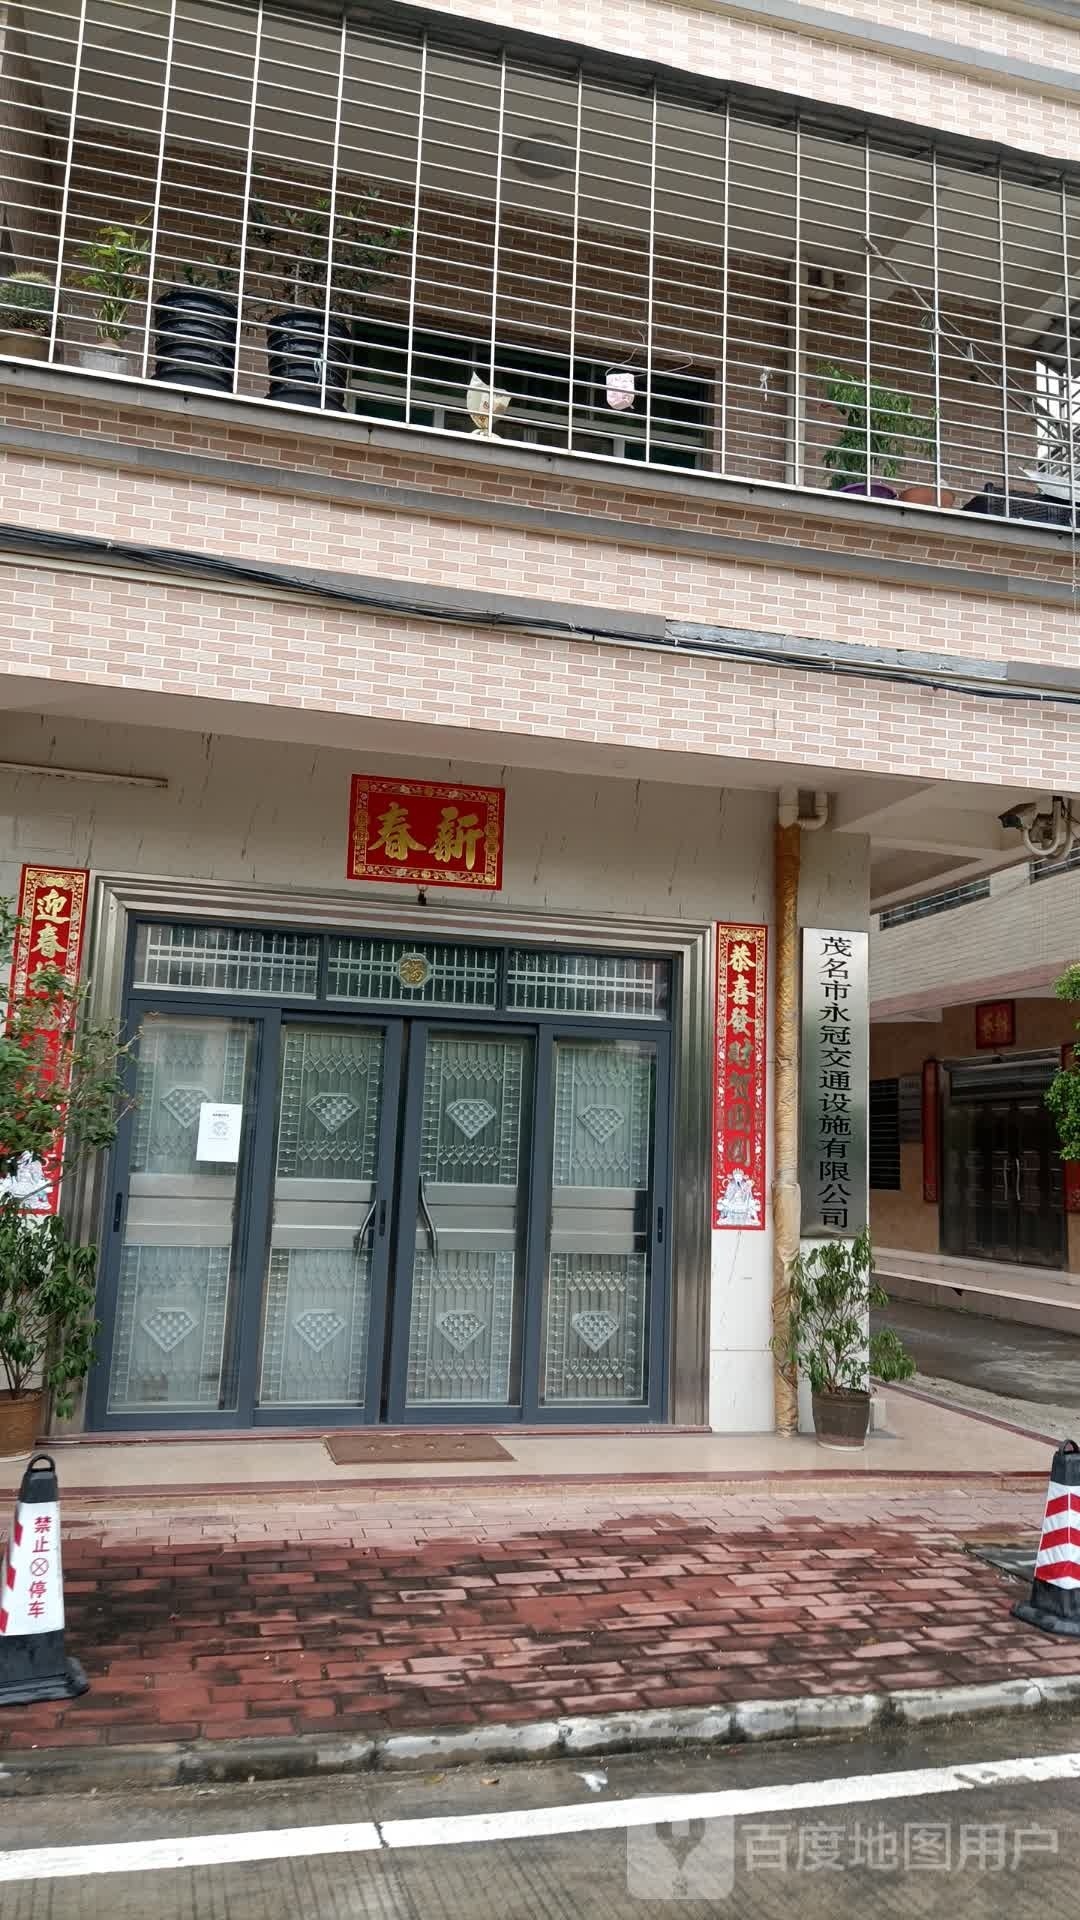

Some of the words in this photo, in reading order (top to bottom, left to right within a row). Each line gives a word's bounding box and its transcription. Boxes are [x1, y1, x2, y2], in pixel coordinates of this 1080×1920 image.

[818, 936, 852, 1229] 茂名市永冠交通设施有限公司
